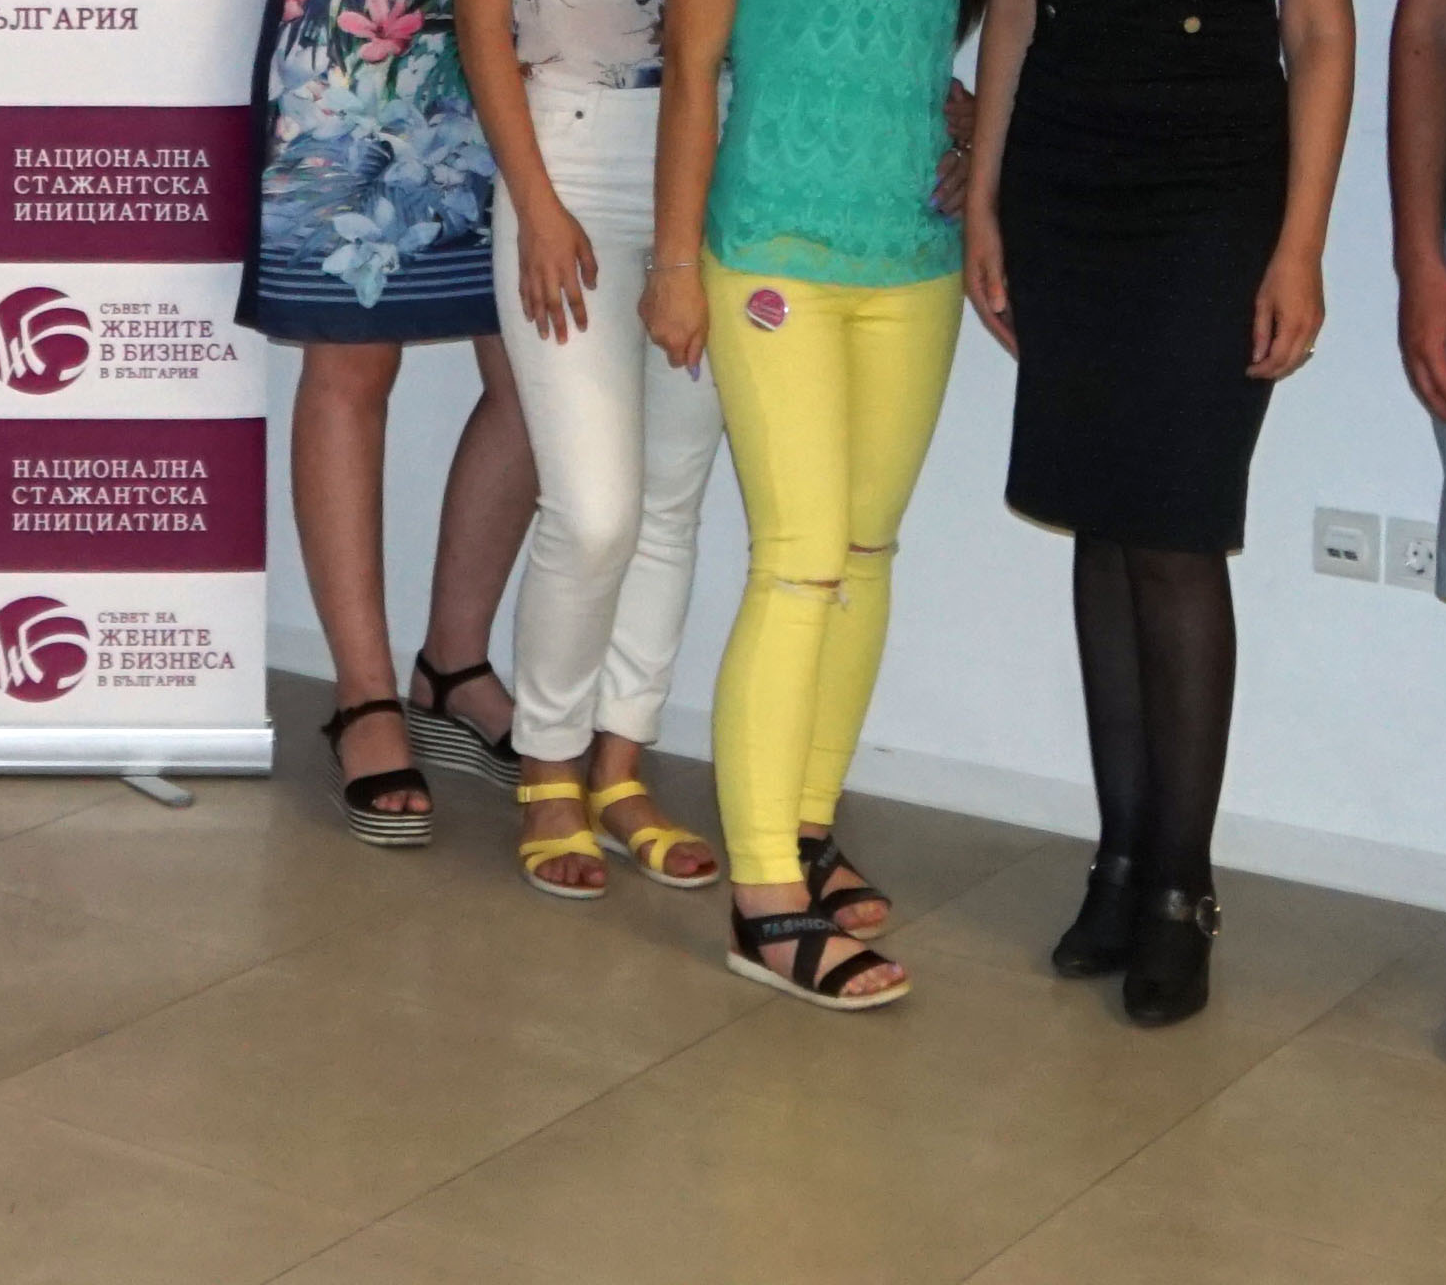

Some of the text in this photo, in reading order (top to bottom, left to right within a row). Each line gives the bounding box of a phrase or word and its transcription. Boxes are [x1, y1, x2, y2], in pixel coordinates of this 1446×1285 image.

[15, 149, 209, 170] НАЦИОНАЛНА
[14, 176, 209, 194] СТАЖАНТСКА
[15, 203, 208, 223] ИНИЦИАТИВА
[100, 303, 179, 314] СЪВЕТ НА
[100, 320, 213, 338] ЖЕНИТЕ
[100, 344, 237, 361] В БИЗНЕСА
[100, 367, 198, 378] В БЪЛГАРИЯ
[13, 460, 208, 480] НАЦИОНАЛНА
[12, 486, 207, 504] СТАЖАНТСКА
[13, 513, 206, 533] ИНИЦИАТИВА
[98, 612, 177, 623] СЪВЕТ НА
[99, 629, 211, 646] ЖЕНИТЕ
[98, 652, 235, 669] В БИЗНЕСА
[98, 675, 196, 686] В БЪЛГАРИЯ
